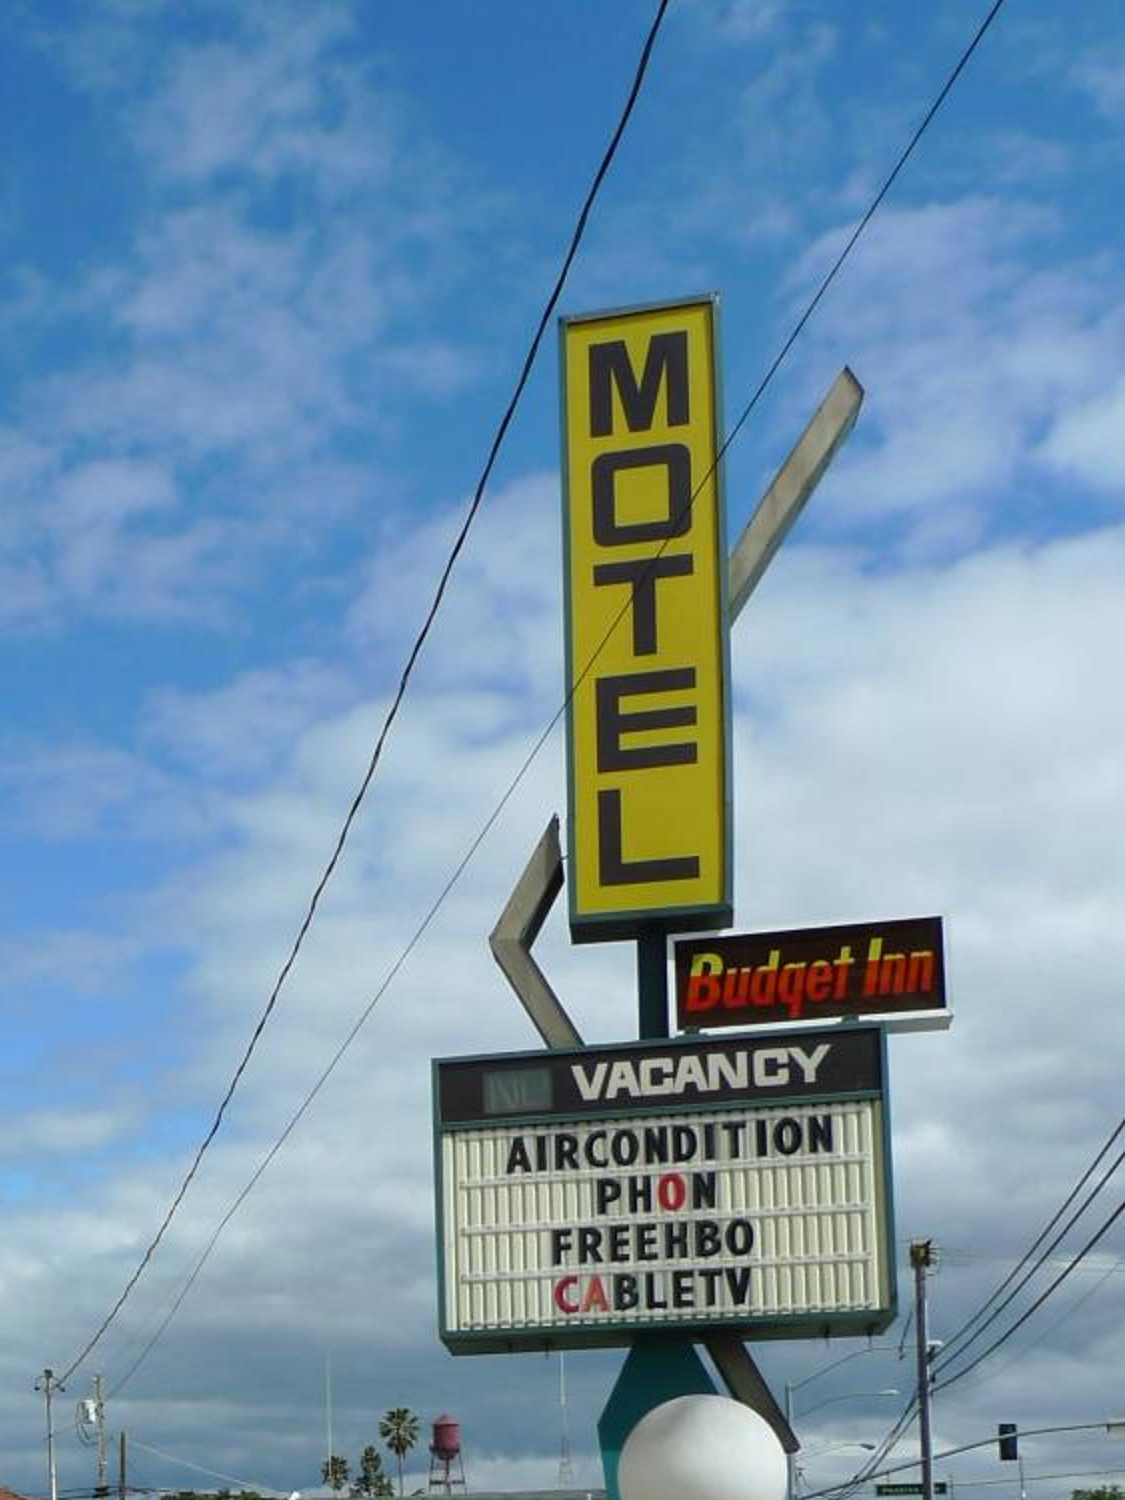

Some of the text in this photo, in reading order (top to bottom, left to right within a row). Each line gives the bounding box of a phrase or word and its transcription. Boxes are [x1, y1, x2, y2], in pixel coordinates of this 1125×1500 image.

[588, 330, 701, 887] MOTEL
[685, 937, 935, 1018] Budget Inn
[571, 1043, 833, 1101] VACANCY
[506, 1113, 834, 1175] AIRCONDITION
[596, 1171, 716, 1215] PHON
